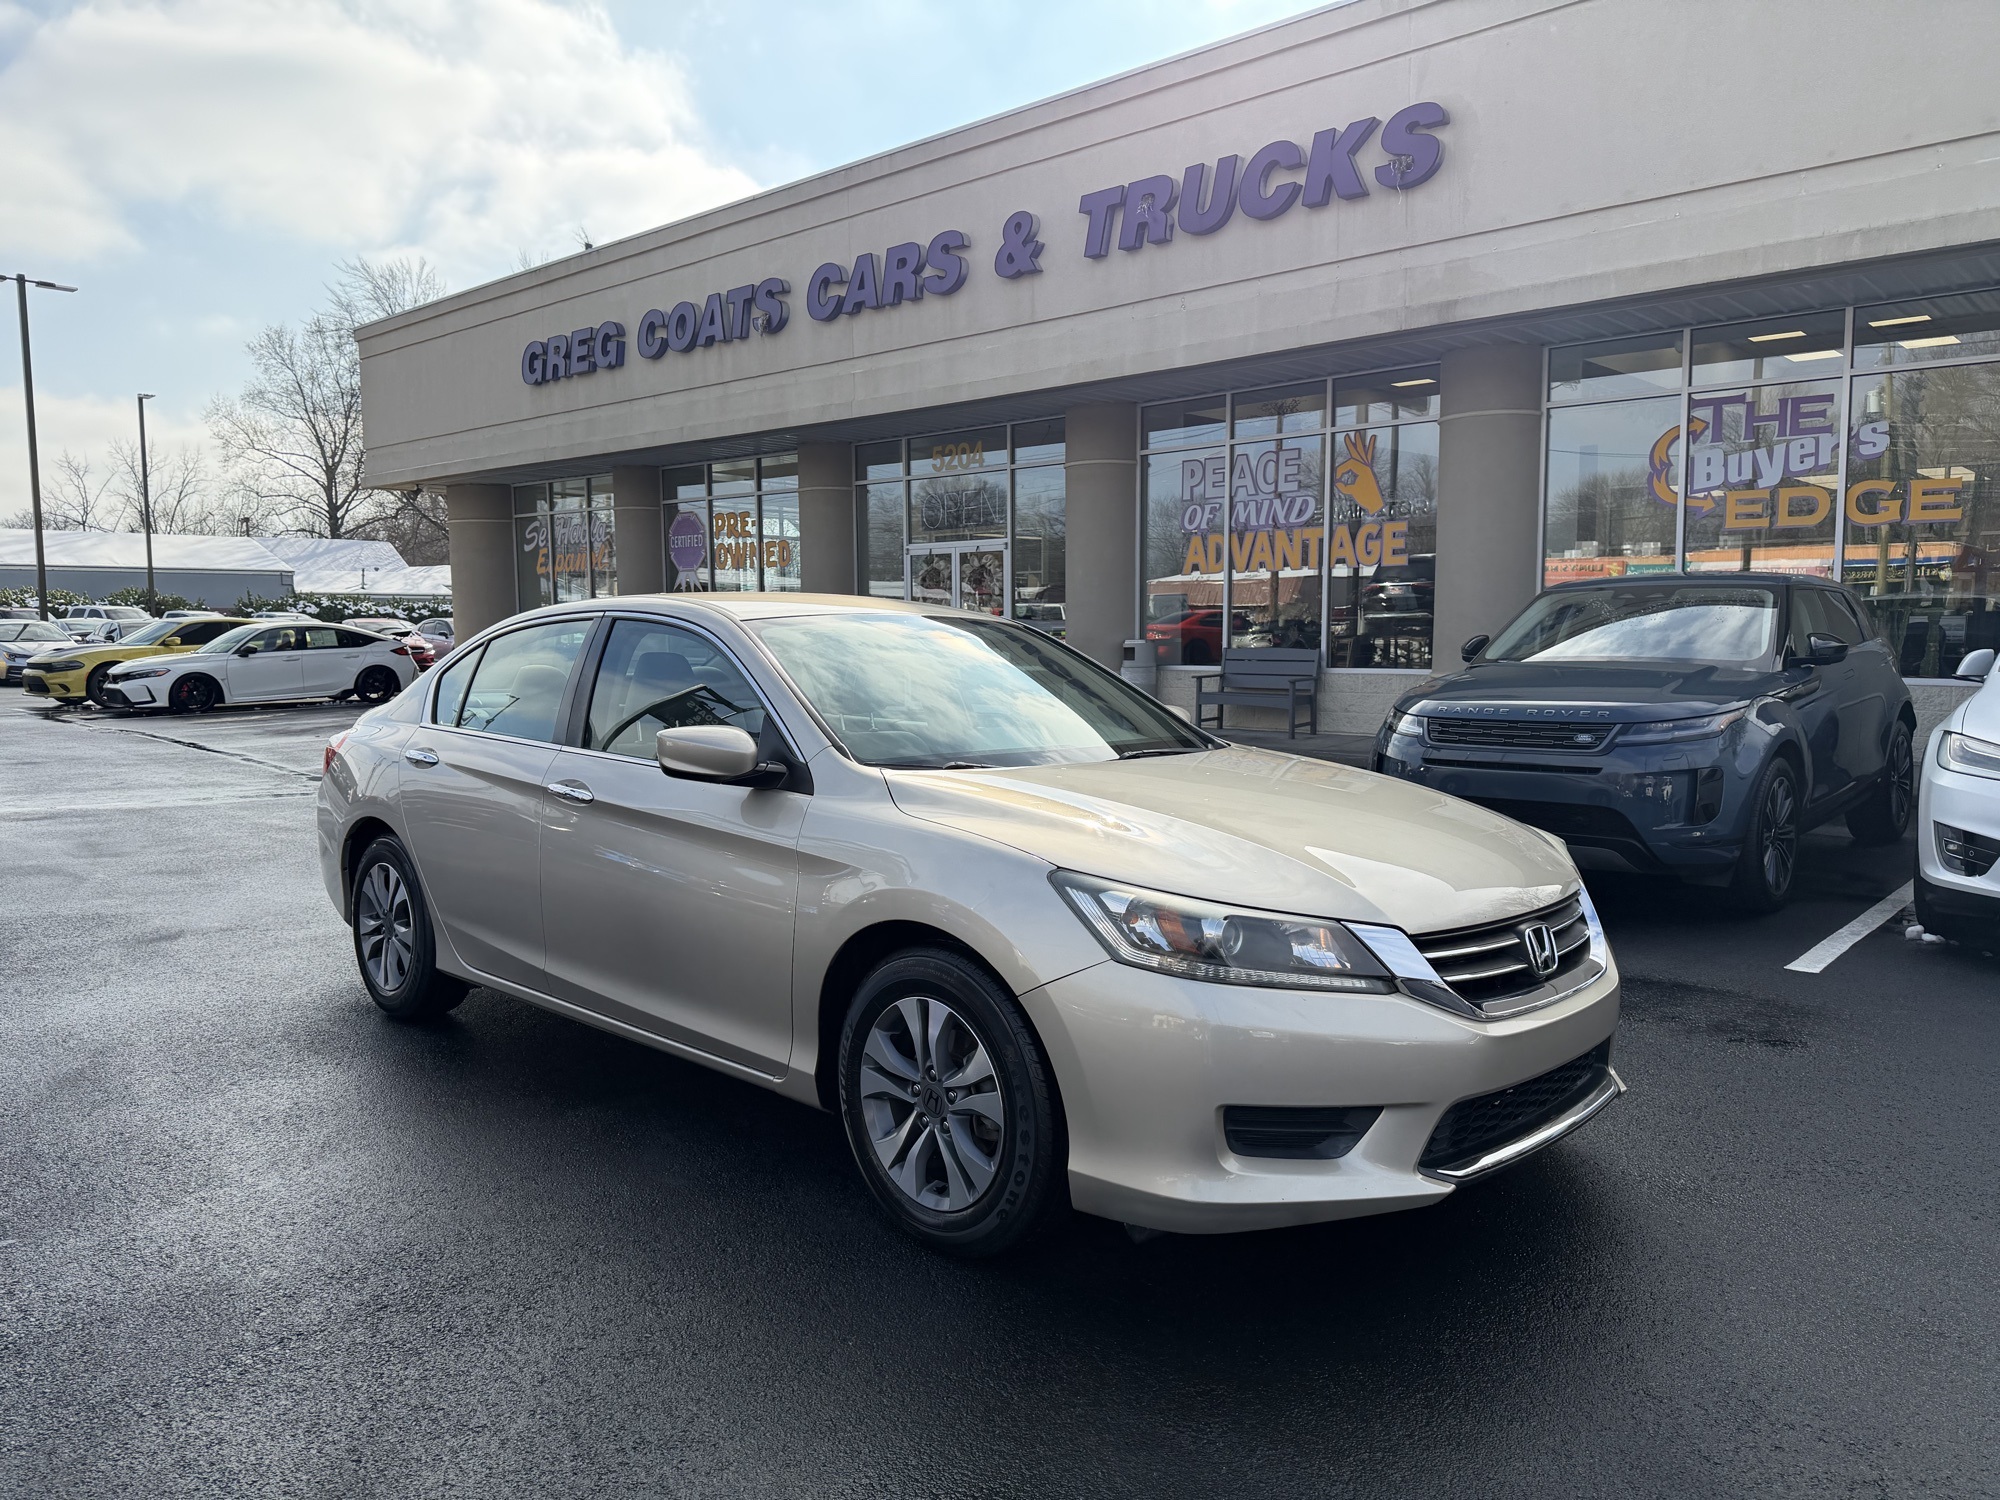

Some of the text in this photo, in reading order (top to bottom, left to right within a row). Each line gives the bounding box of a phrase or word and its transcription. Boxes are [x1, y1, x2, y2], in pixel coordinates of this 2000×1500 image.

[521, 102, 1451, 386] GREG COATS CARS & TRUCKS
[1690, 392, 1835, 447] THE
[931, 440, 985, 472] 5204
[1181, 448, 1302, 501] PEACE
[922, 488, 1003, 529] OPEN
[1181, 503, 1221, 531] OF
[1230, 496, 1317, 528] MIND
[1724, 476, 1963, 530] EDGE
[523, 520, 548, 552] Se
[670, 534, 704, 549] CERTIFIED
[715, 540, 791, 570] OWNED
[1181, 520, 1410, 576] ADVANTAGE
[1437, 706, 1610, 718] RANGE ROVER
